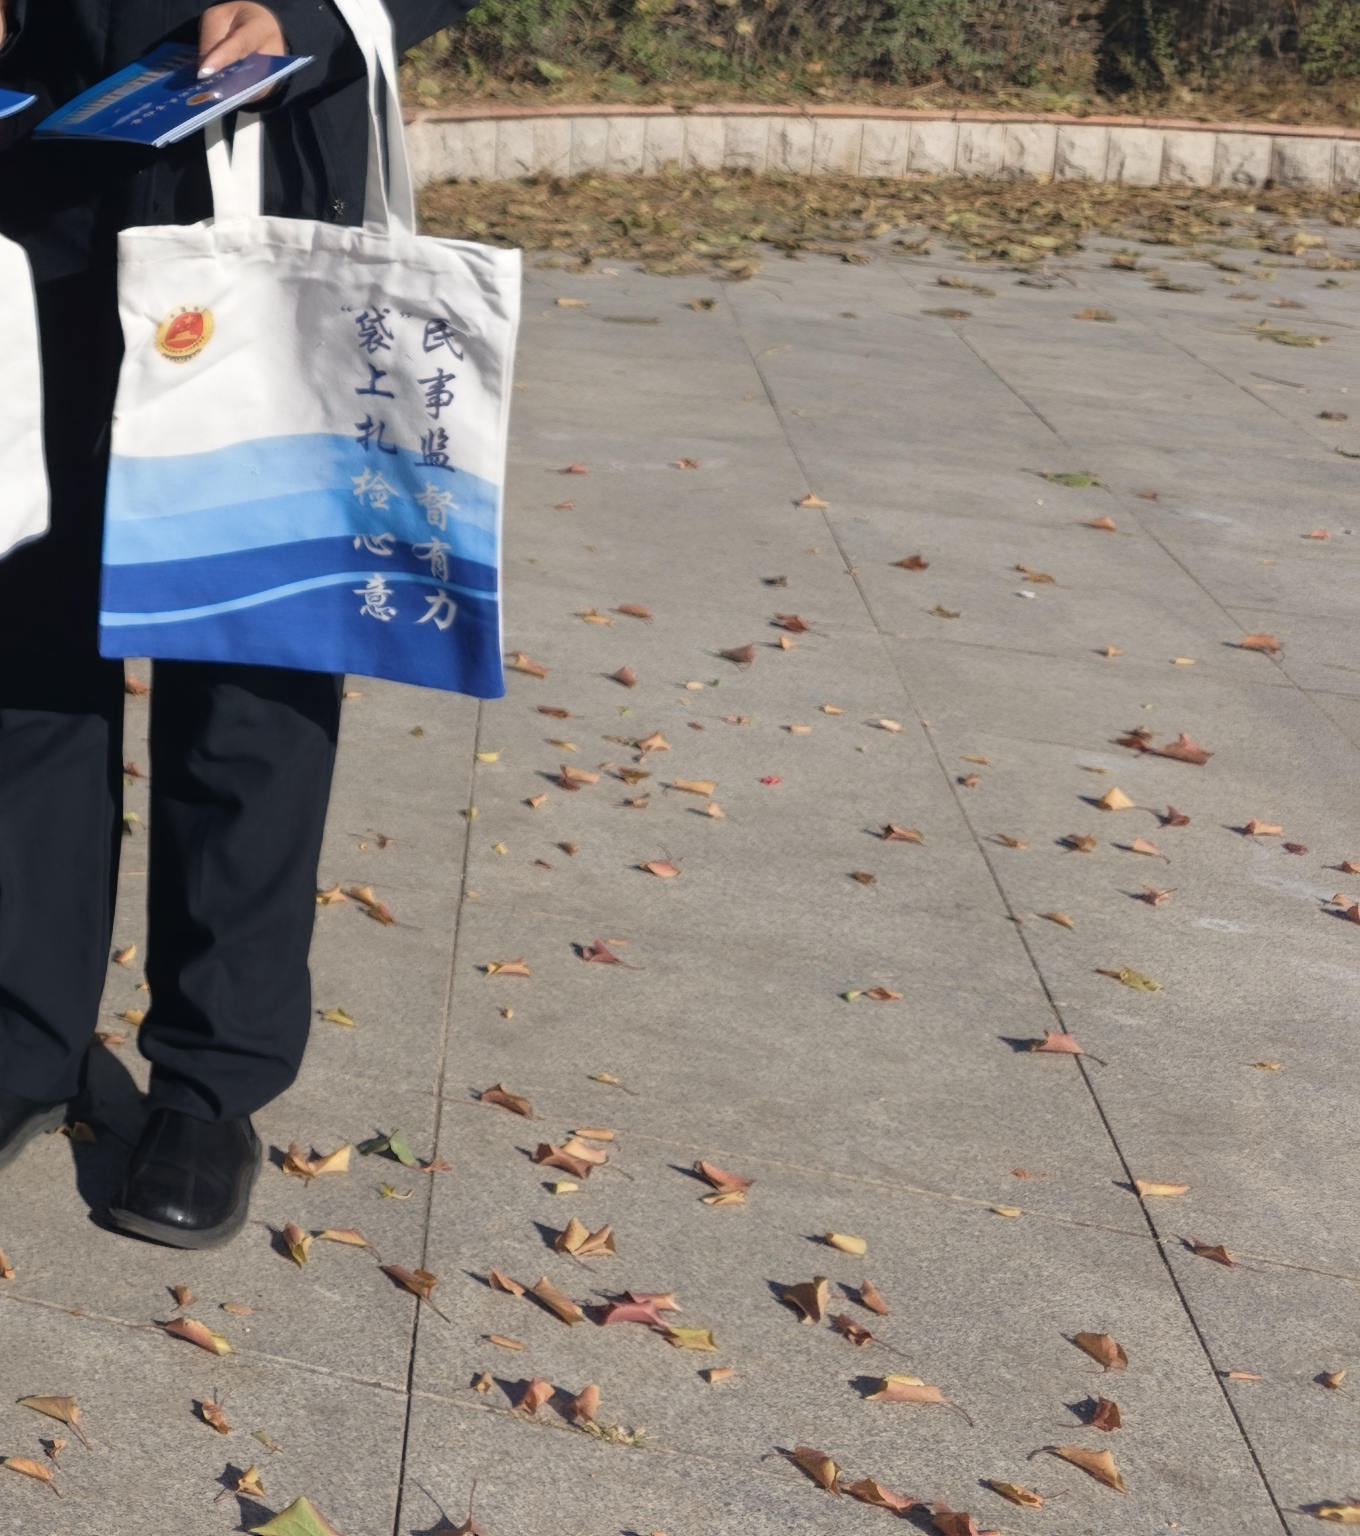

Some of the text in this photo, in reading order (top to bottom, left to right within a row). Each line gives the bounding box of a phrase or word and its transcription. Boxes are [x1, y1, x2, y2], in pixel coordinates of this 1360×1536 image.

[412, 317, 465, 631] 民事监督有力
